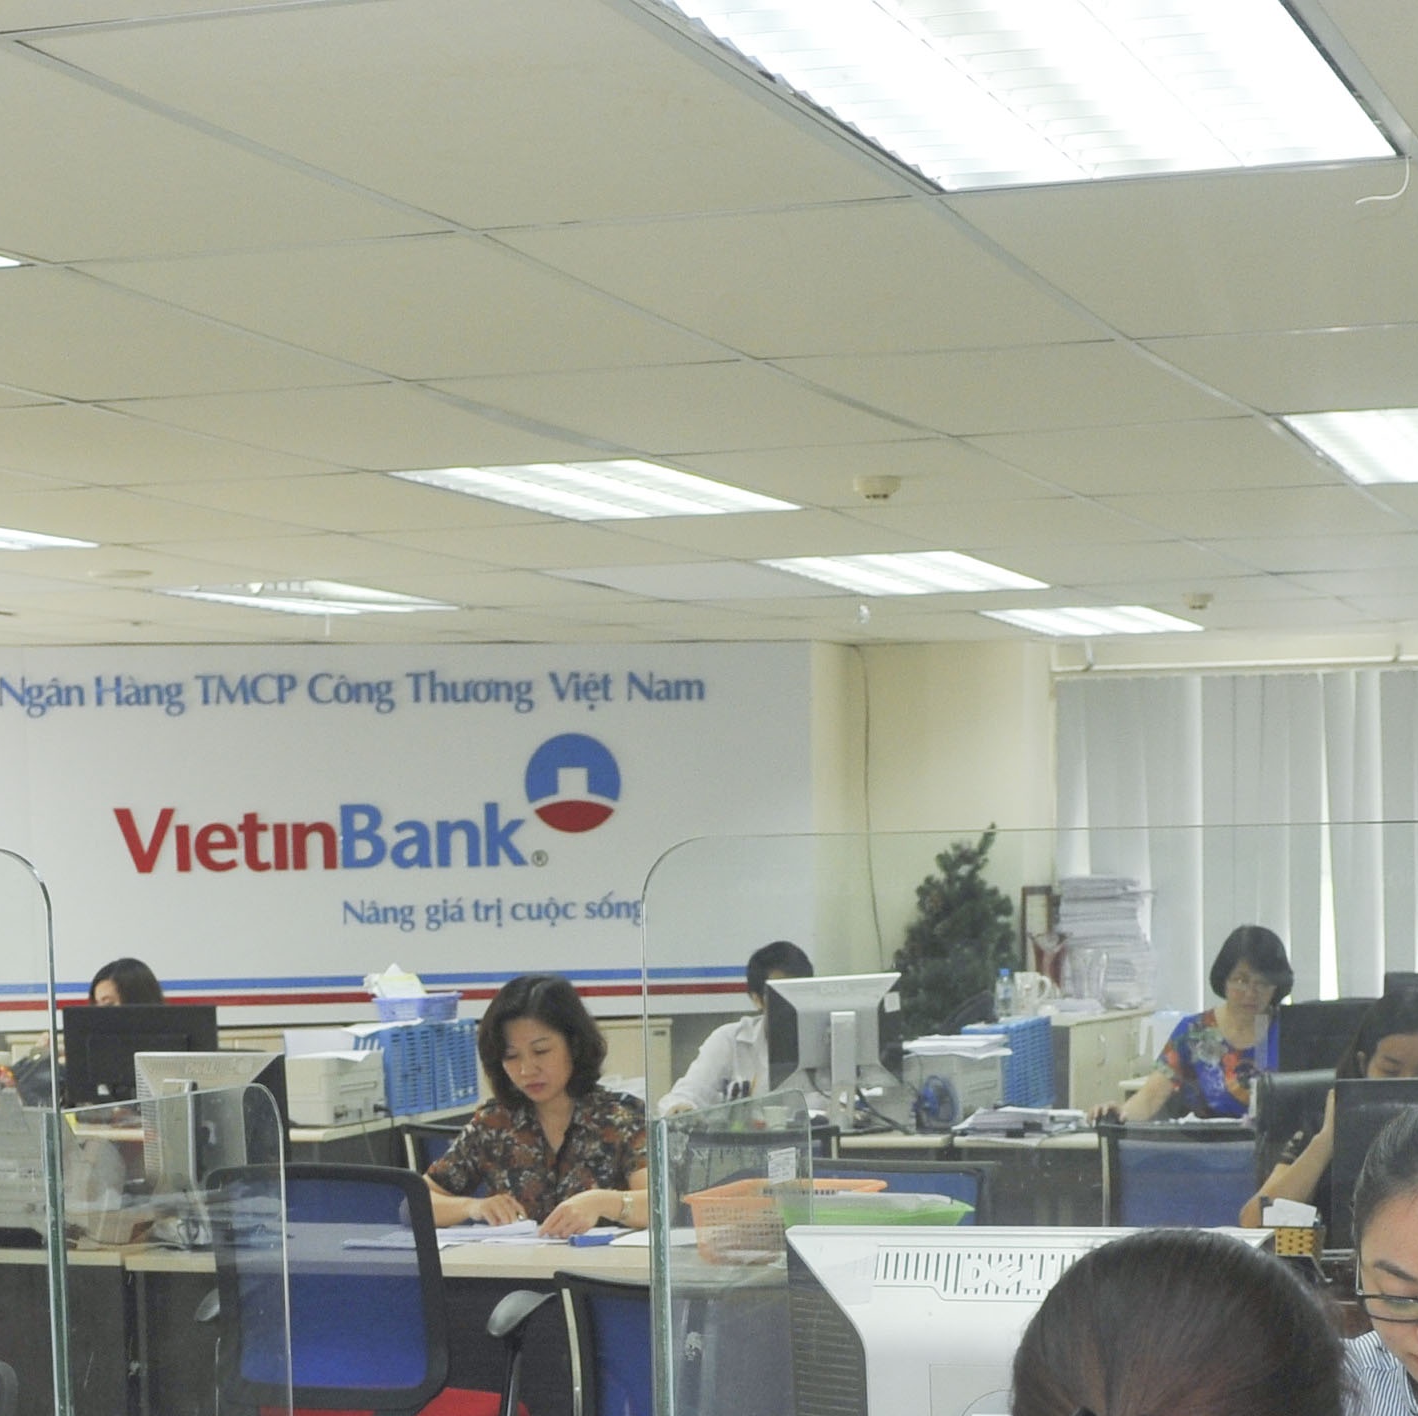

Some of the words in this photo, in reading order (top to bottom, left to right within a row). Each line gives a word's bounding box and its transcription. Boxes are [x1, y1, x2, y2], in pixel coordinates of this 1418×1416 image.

[95, 674, 186, 717] Hàng
[195, 674, 297, 706] TMCP
[307, 673, 396, 714] Công
[406, 669, 534, 714] Thương
[548, 670, 614, 712] Việt
[627, 671, 706, 702] Nam
[113, 802, 529, 873] VietinBank
[342, 899, 415, 932] Nâng
[425, 897, 465, 931] giá
[472, 898, 503, 928] trị
[510, 897, 577, 927] cuộc
[584, 891, 644, 927] sống
